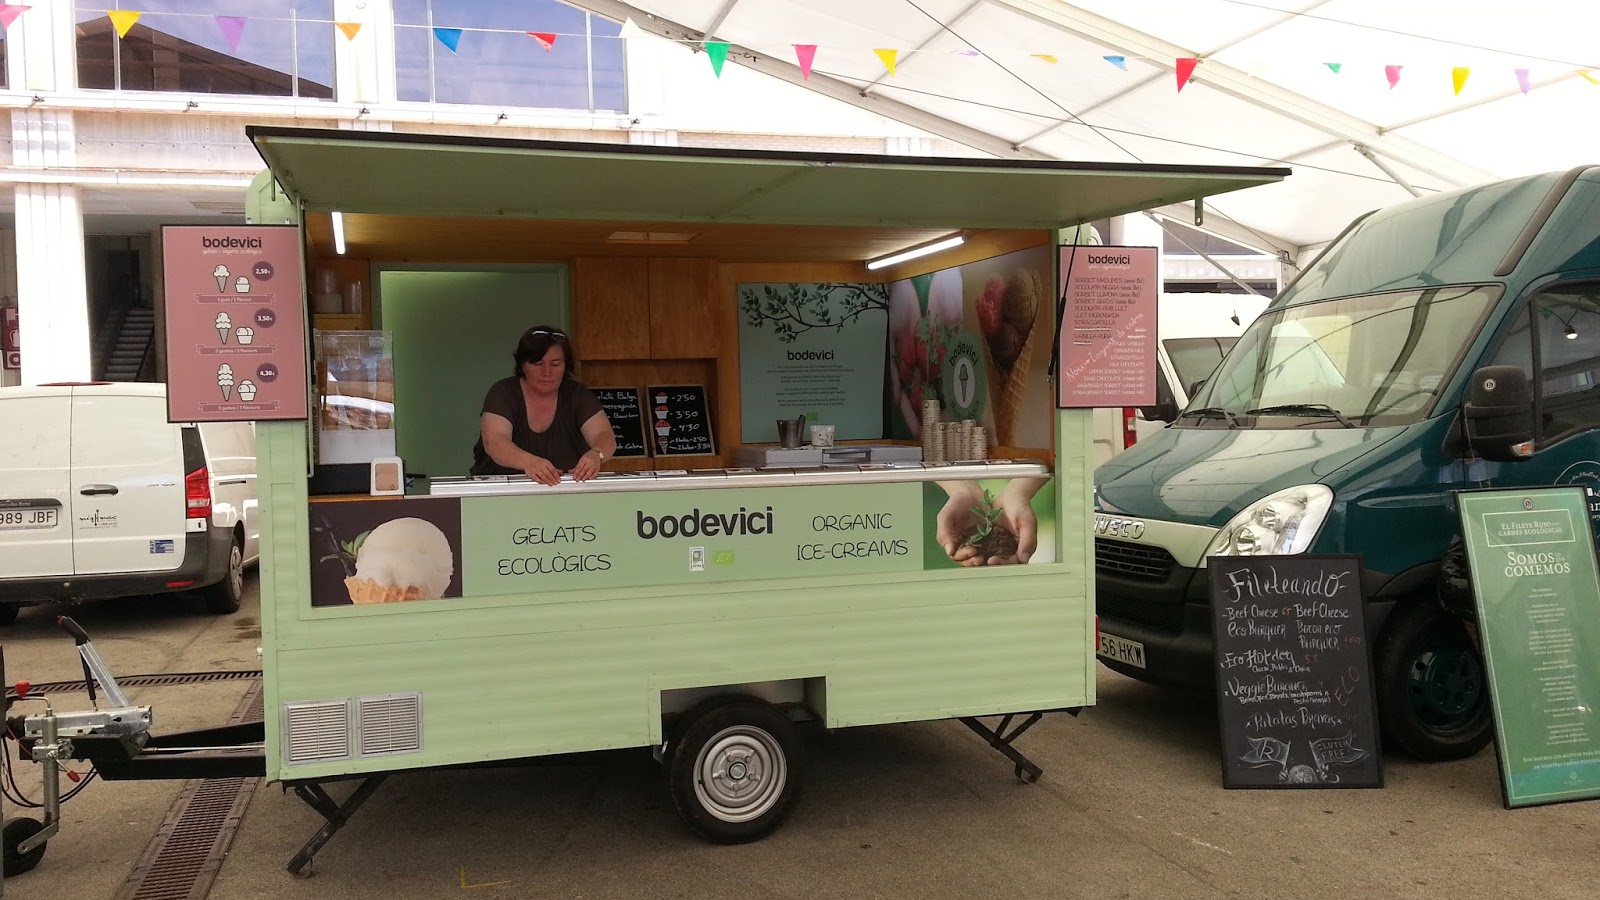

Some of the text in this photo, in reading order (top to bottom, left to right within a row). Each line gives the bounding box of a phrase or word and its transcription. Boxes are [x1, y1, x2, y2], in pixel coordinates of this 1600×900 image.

[202, 236, 262, 248] bodevici
[1088, 255, 1130, 264] bodevici
[787, 350, 834, 360] bodevici
[949, 342, 979, 366] bodevici
[28, 511, 54, 524] JBF
[637, 506, 773, 539] bodevici
[812, 513, 892, 532] ORGANIC
[1094, 515, 1145, 539] IVECO
[512, 525, 596, 545] GELATS
[797, 539, 909, 561] ICE-CREAMS
[498, 552, 612, 576] ECOLÒGICS
[1504, 562, 1571, 577] COMEMOS
[1118, 639, 1143, 665] HKW
[1252, 710, 1298, 731] Patatas
